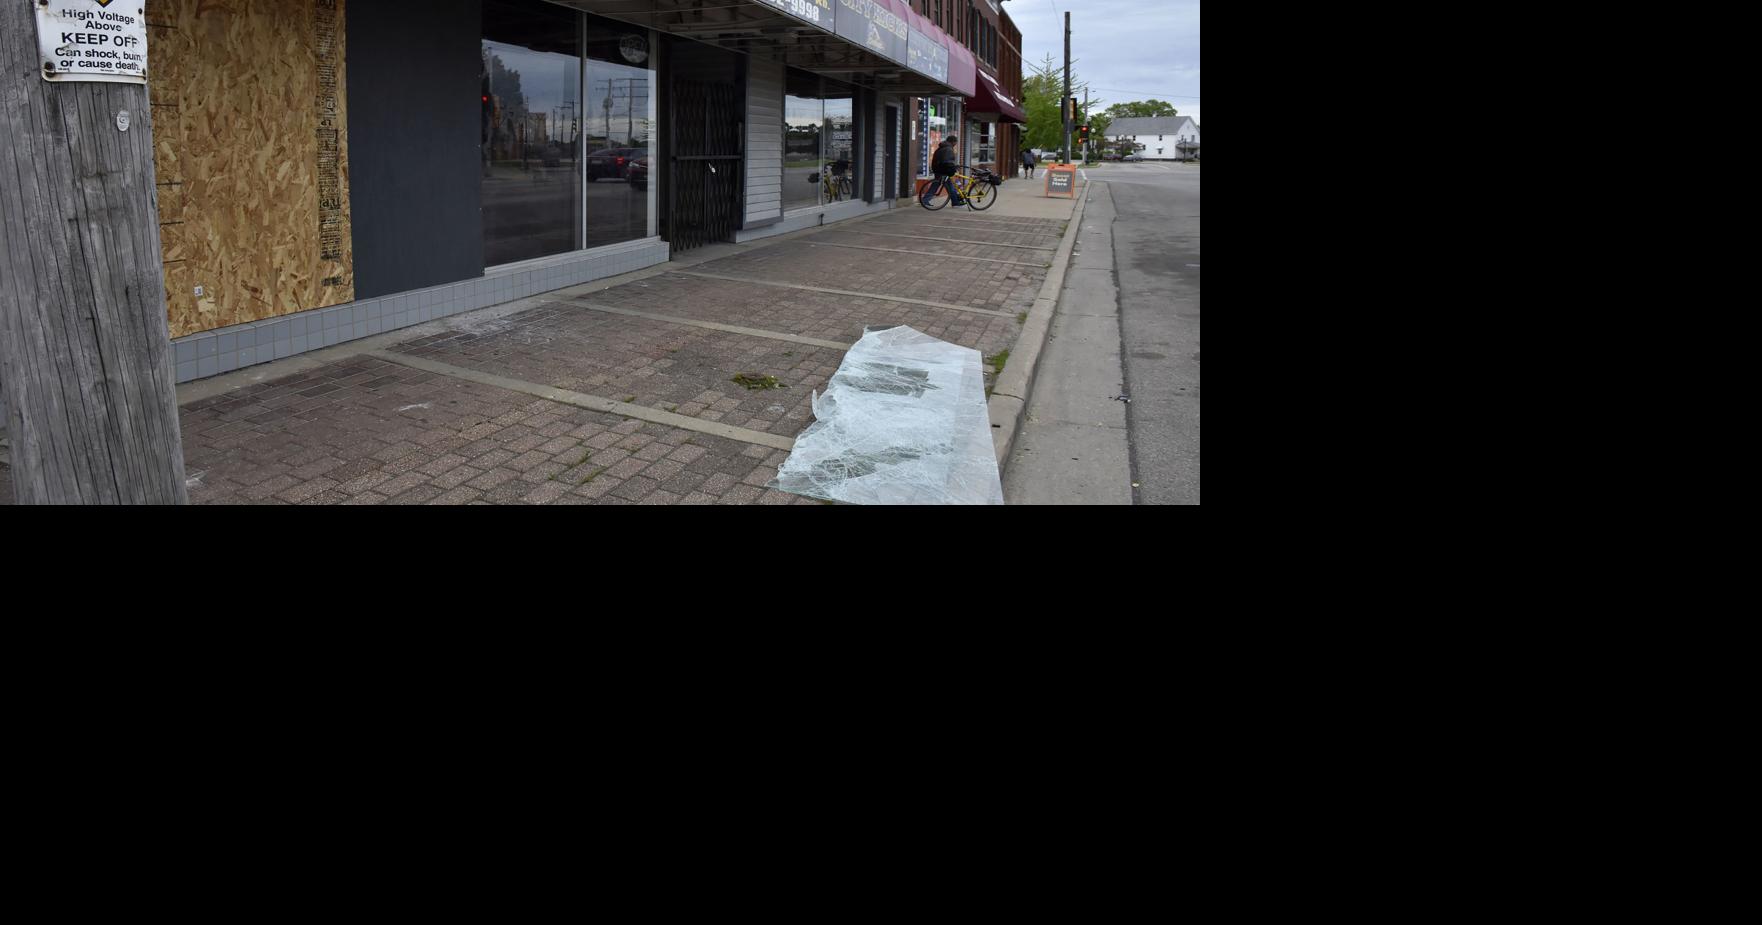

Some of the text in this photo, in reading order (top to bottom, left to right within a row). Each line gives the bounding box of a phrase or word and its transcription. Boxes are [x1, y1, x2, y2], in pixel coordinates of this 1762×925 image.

[62, 9, 135, 25] High Voltage
[768, 0, 819, 21] -9998
[85, 21, 122, 31] Above
[61, 32, 138, 48] KEEP OFF
[55, 47, 143, 62] Can shock, burn,
[60, 60, 74, 68] or
[78, 60, 113, 69] cause
[115, 61, 141, 70] death.
